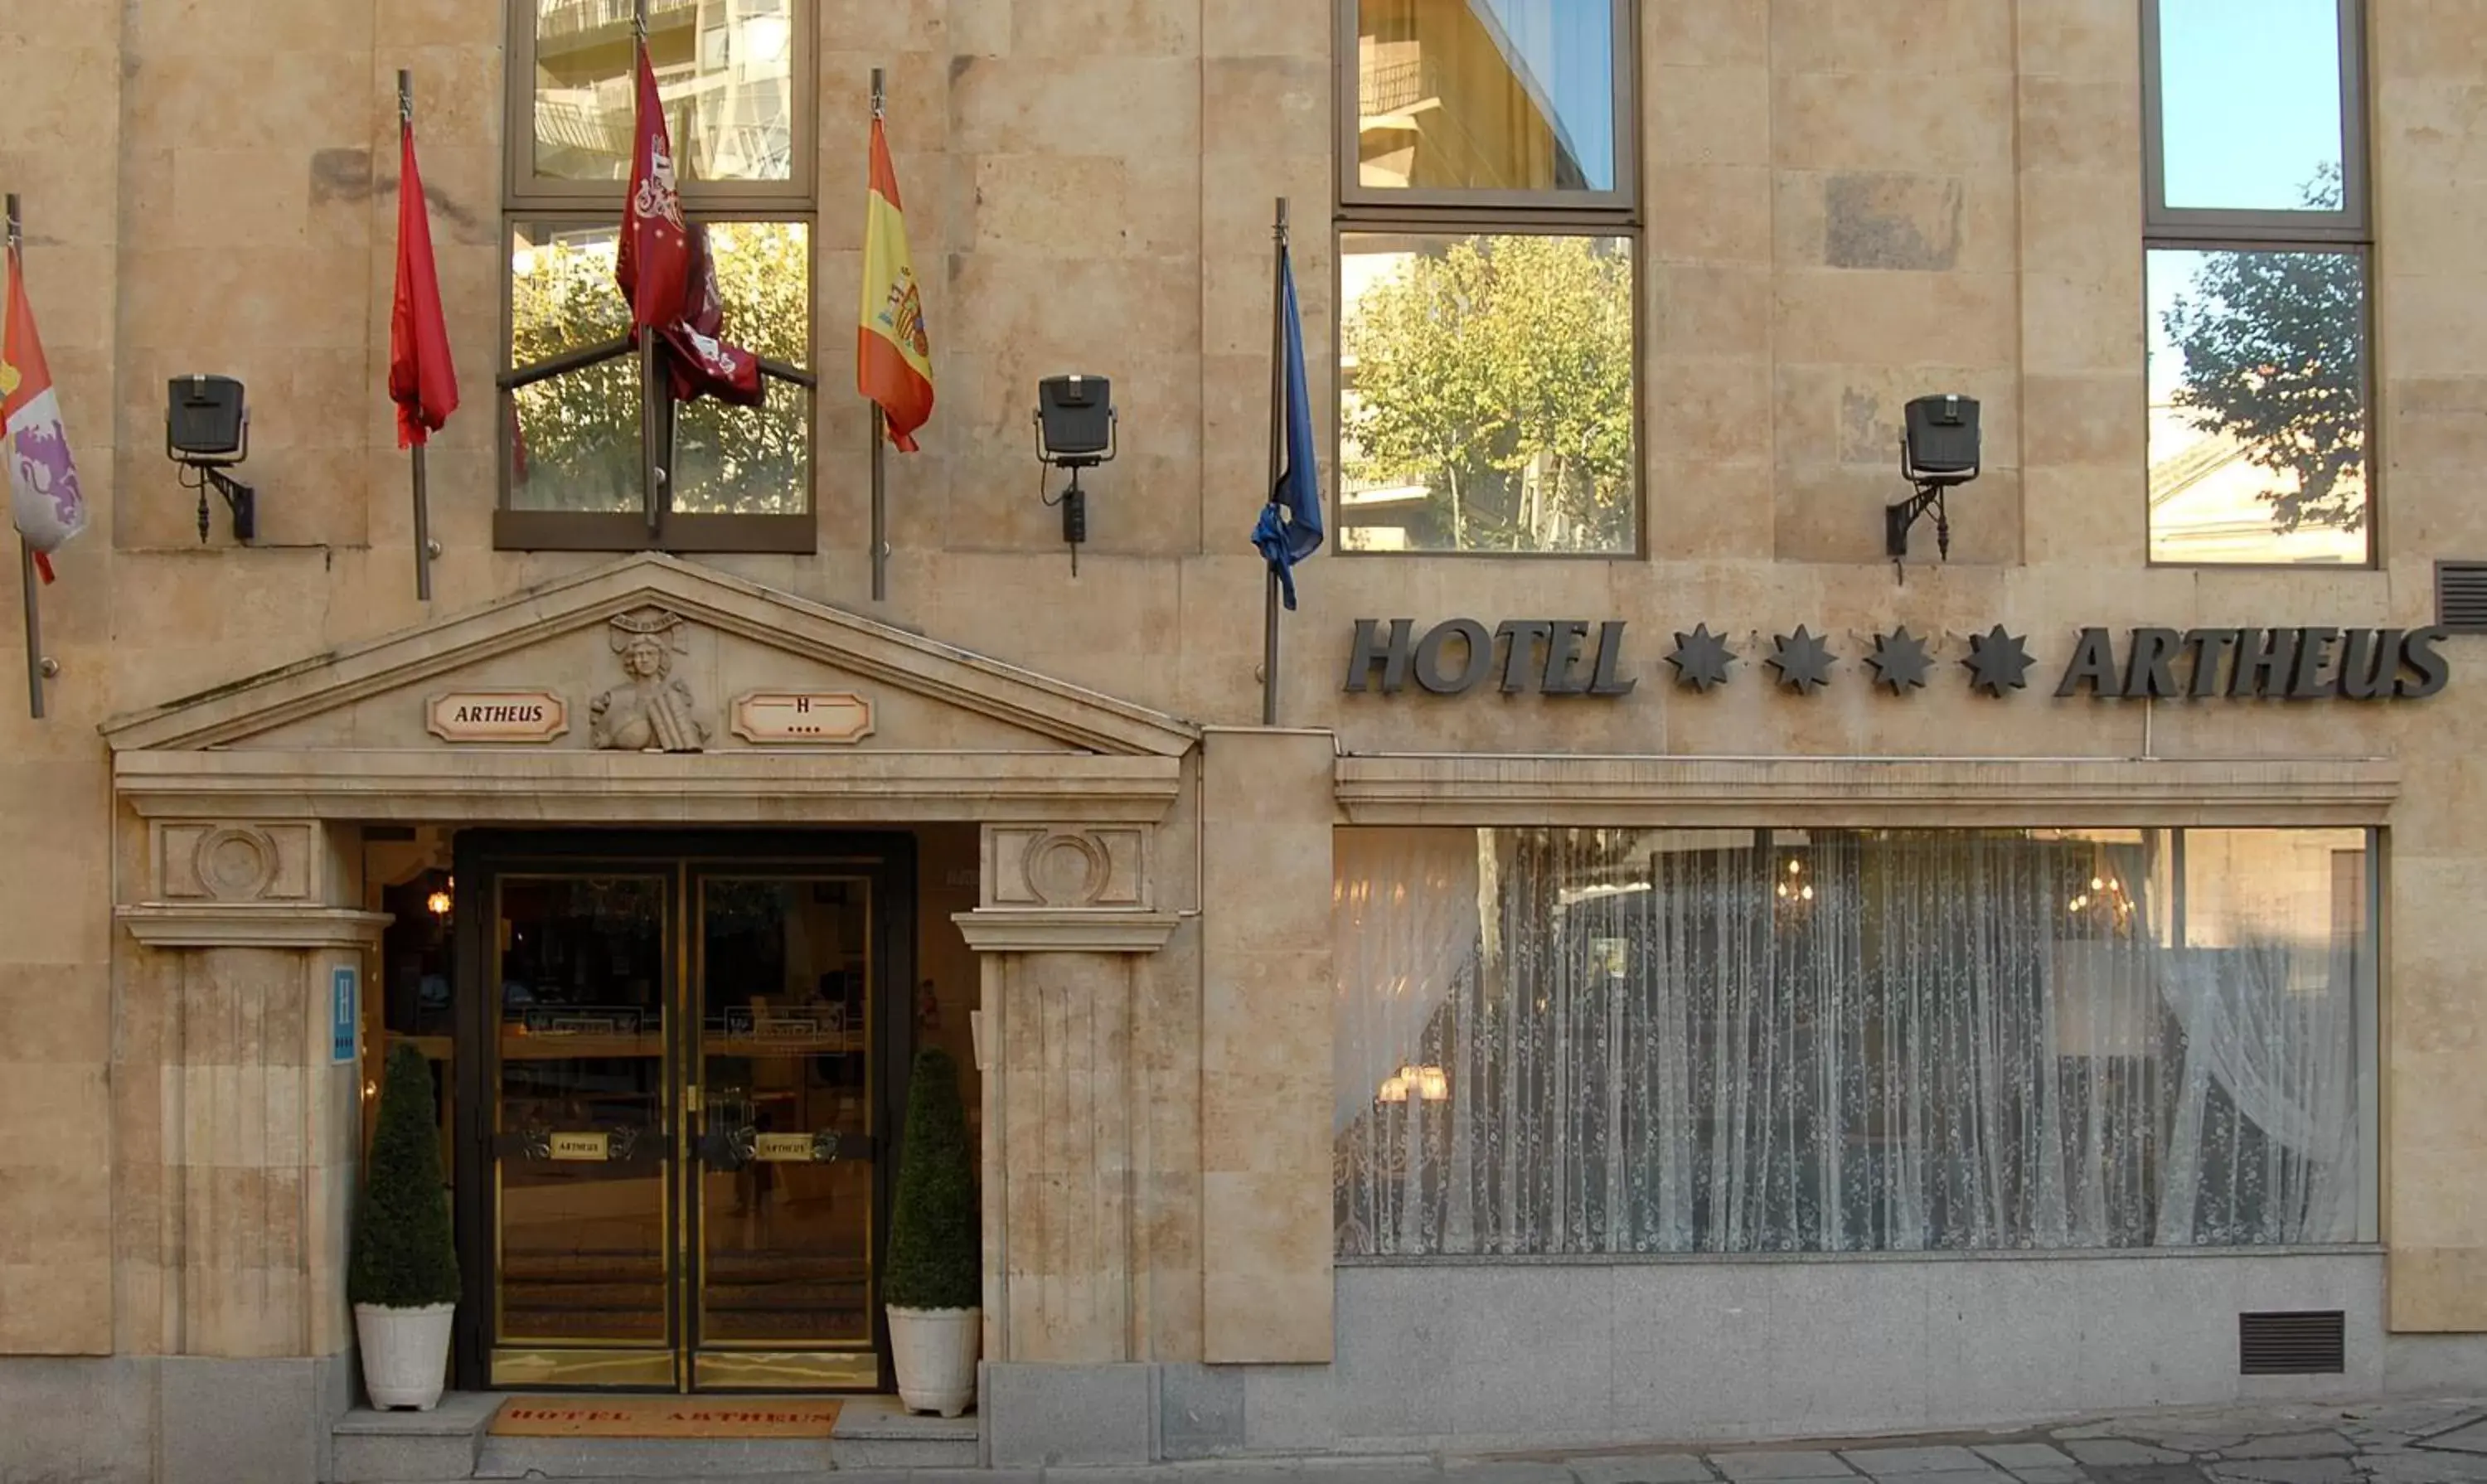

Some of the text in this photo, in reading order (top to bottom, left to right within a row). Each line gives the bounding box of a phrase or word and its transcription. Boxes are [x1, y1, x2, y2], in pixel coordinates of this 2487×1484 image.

[1342, 618, 2450, 700] HOTEL ARTHEUS
[797, 696, 809, 713] H
[455, 706, 543, 722] ARTHEUS
[338, 978, 351, 1024] H
[511, 1410, 631, 1420] HOTEL
